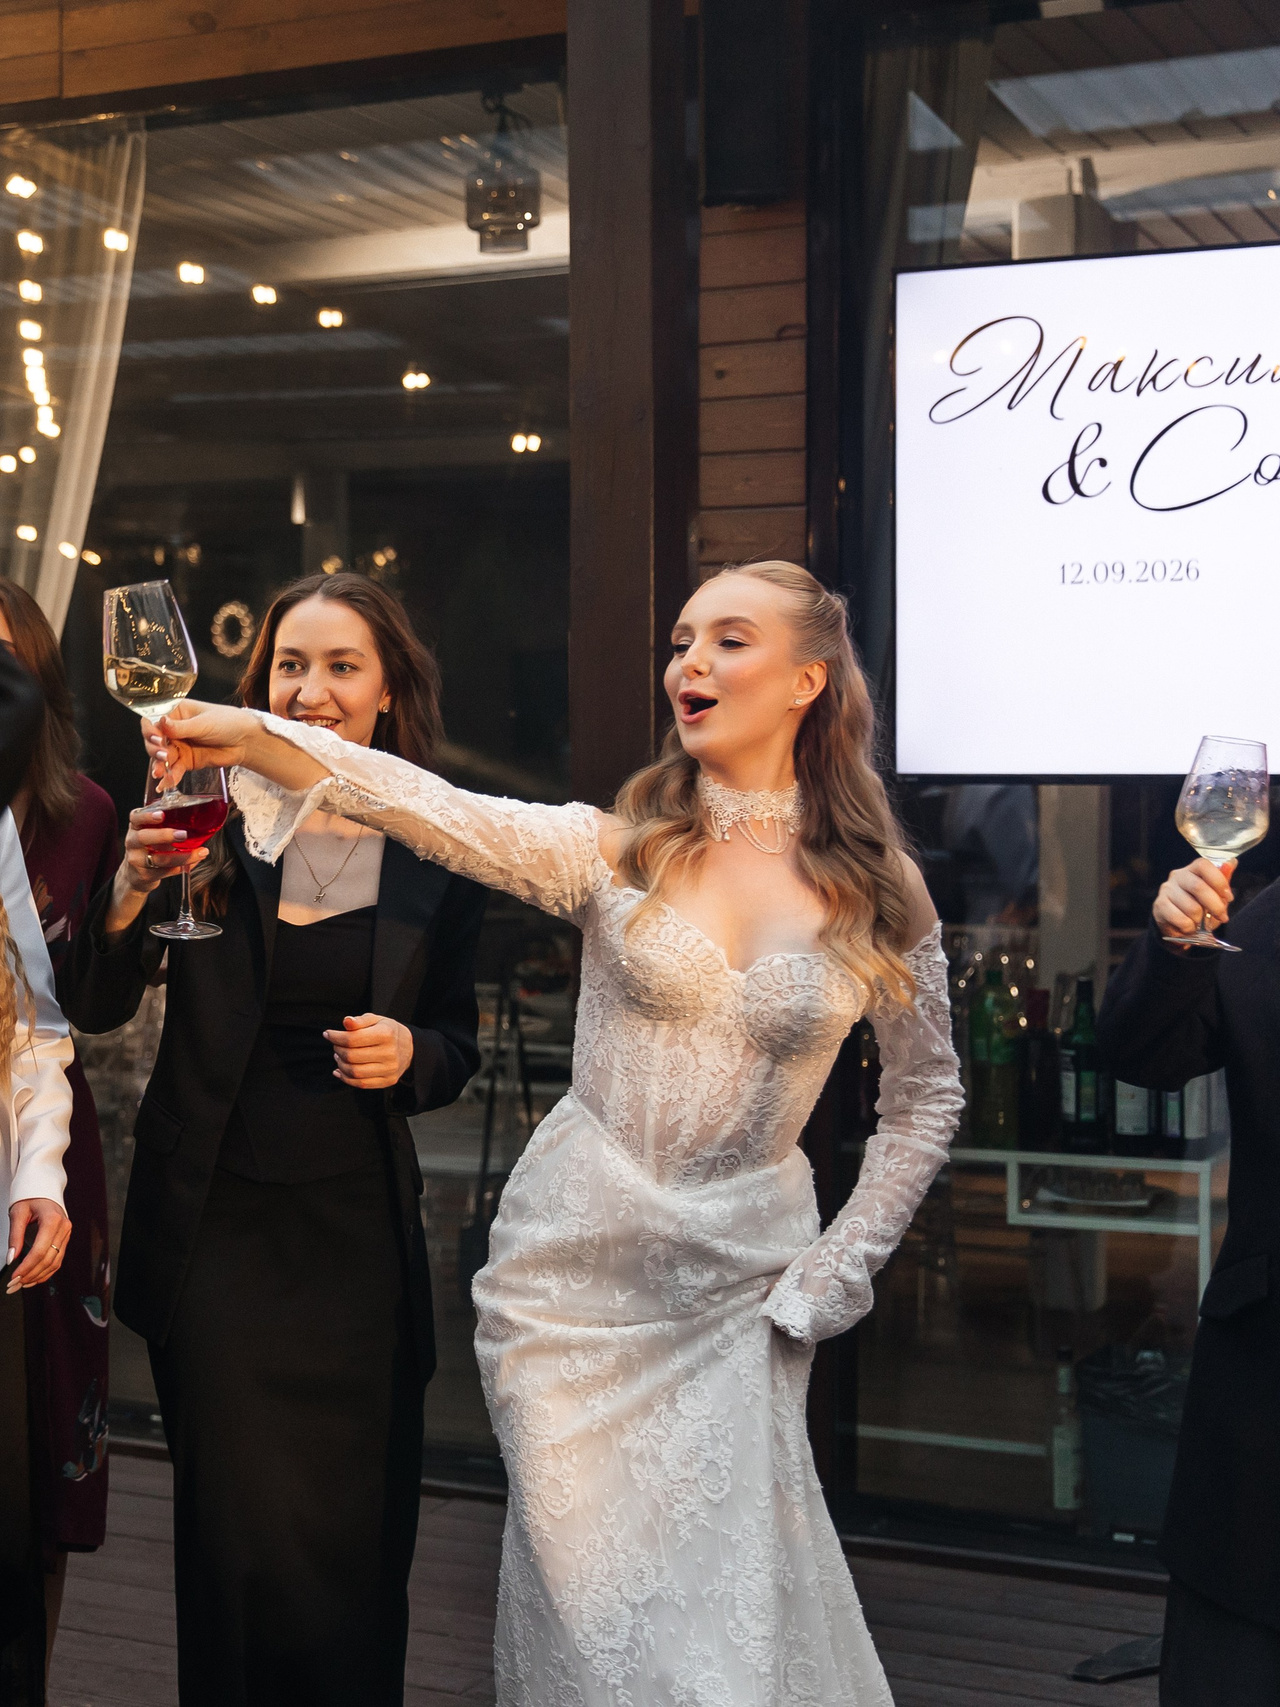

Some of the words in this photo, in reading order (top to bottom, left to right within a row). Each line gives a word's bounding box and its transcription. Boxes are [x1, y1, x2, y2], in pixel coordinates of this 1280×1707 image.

[929, 316, 1280, 424] Макси
[1041, 422, 1112, 505] &
[1060, 559, 1200, 585] 12.09.2026
